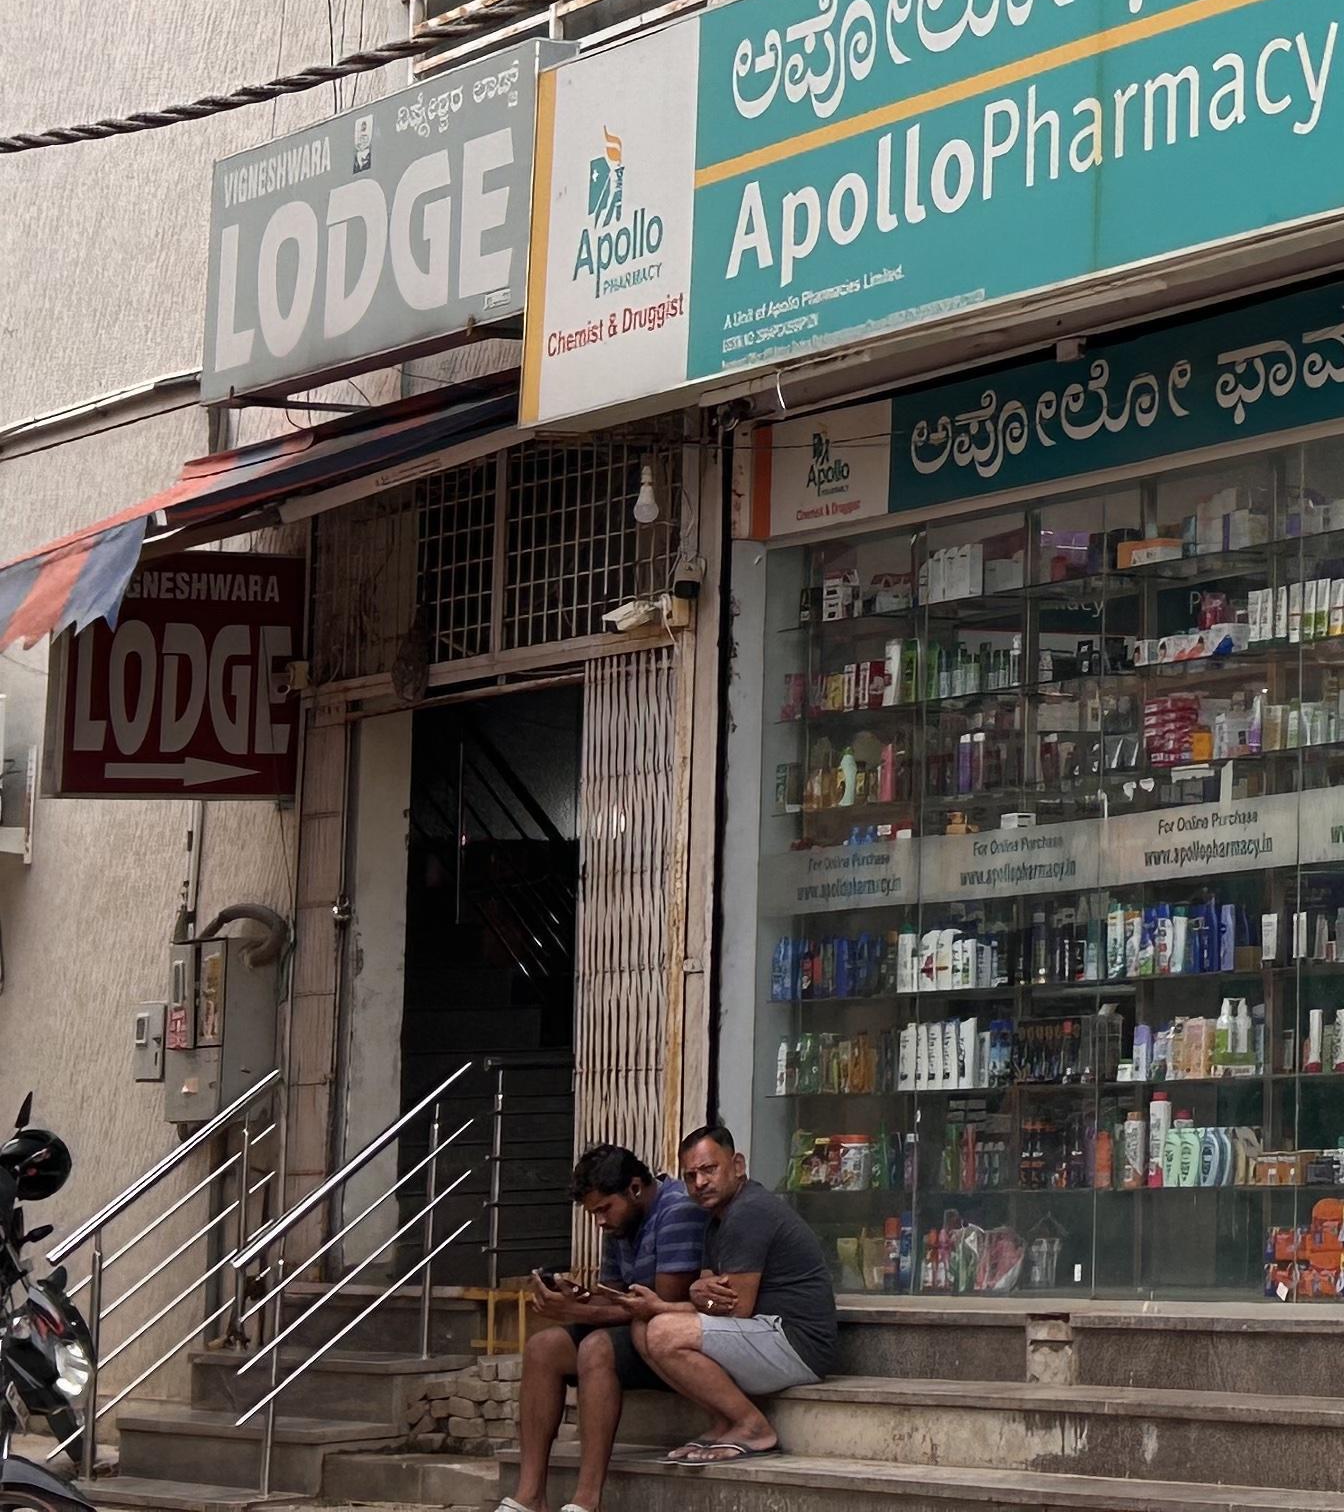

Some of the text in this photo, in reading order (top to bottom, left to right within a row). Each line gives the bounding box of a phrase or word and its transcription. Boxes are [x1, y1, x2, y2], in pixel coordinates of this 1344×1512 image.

[223, 137, 331, 209] VIGNESHWARA
[215, 127, 516, 373] LODGE
[572, 205, 664, 299] Apollo
[547, 321, 604, 358] Chemist
[607, 312, 618, 336] &
[621, 292, 685, 336] Druggist
[126, 570, 279, 603] GNESHWARA
[73, 620, 293, 756] LODGE
